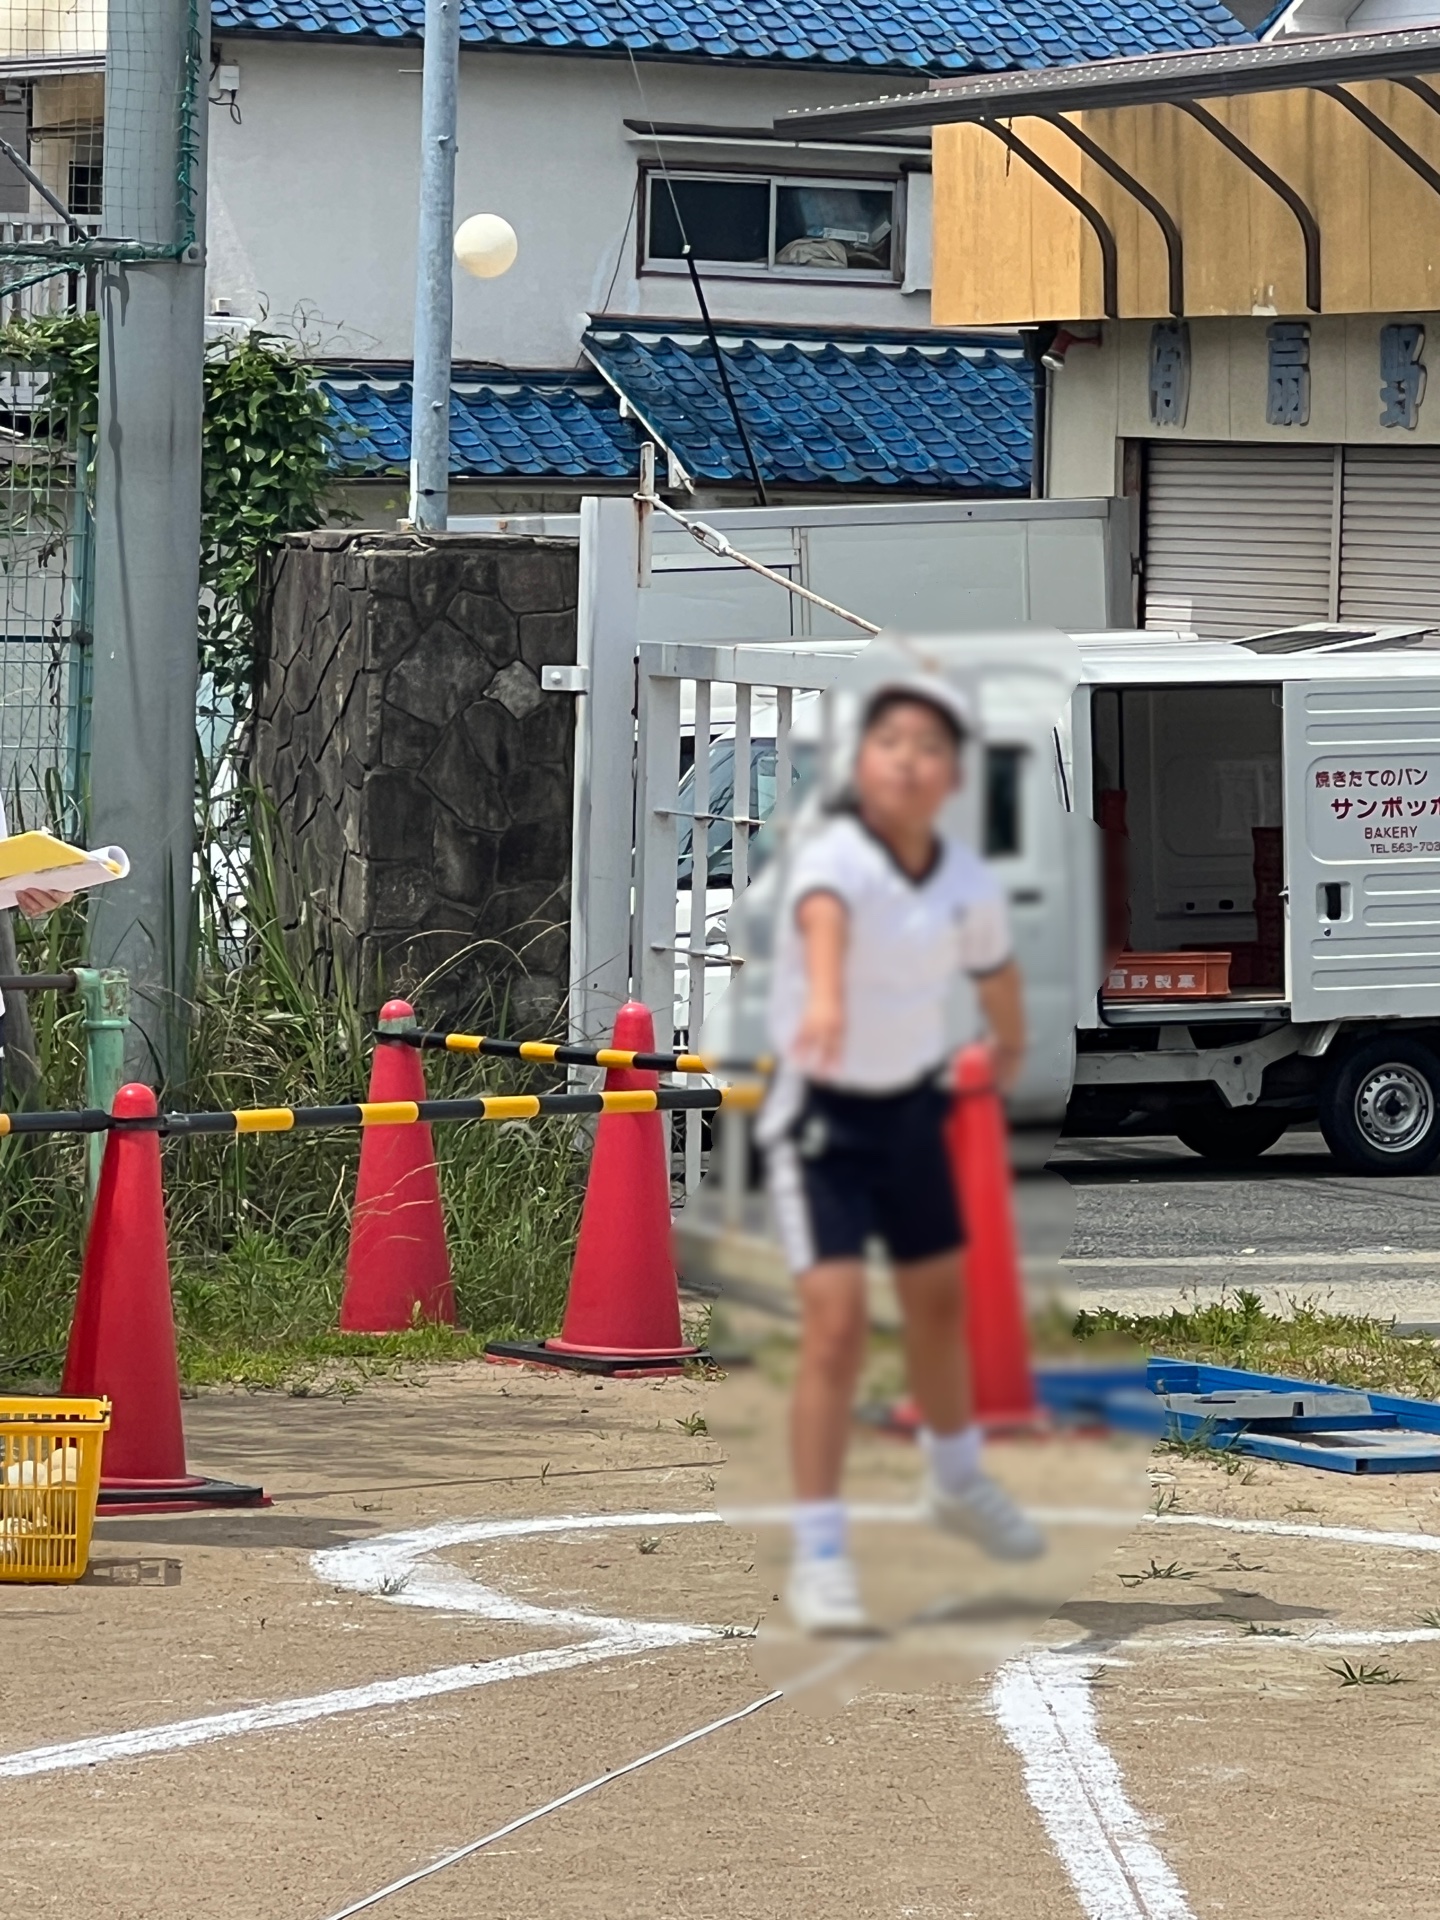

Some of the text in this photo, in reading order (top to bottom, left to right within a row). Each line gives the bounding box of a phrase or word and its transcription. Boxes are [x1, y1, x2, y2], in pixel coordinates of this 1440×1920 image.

[1315, 768, 1428, 788] 焼きたてのパン
[1364, 826, 1418, 839] BAKERY
[1370, 843, 1389, 853] TEL
